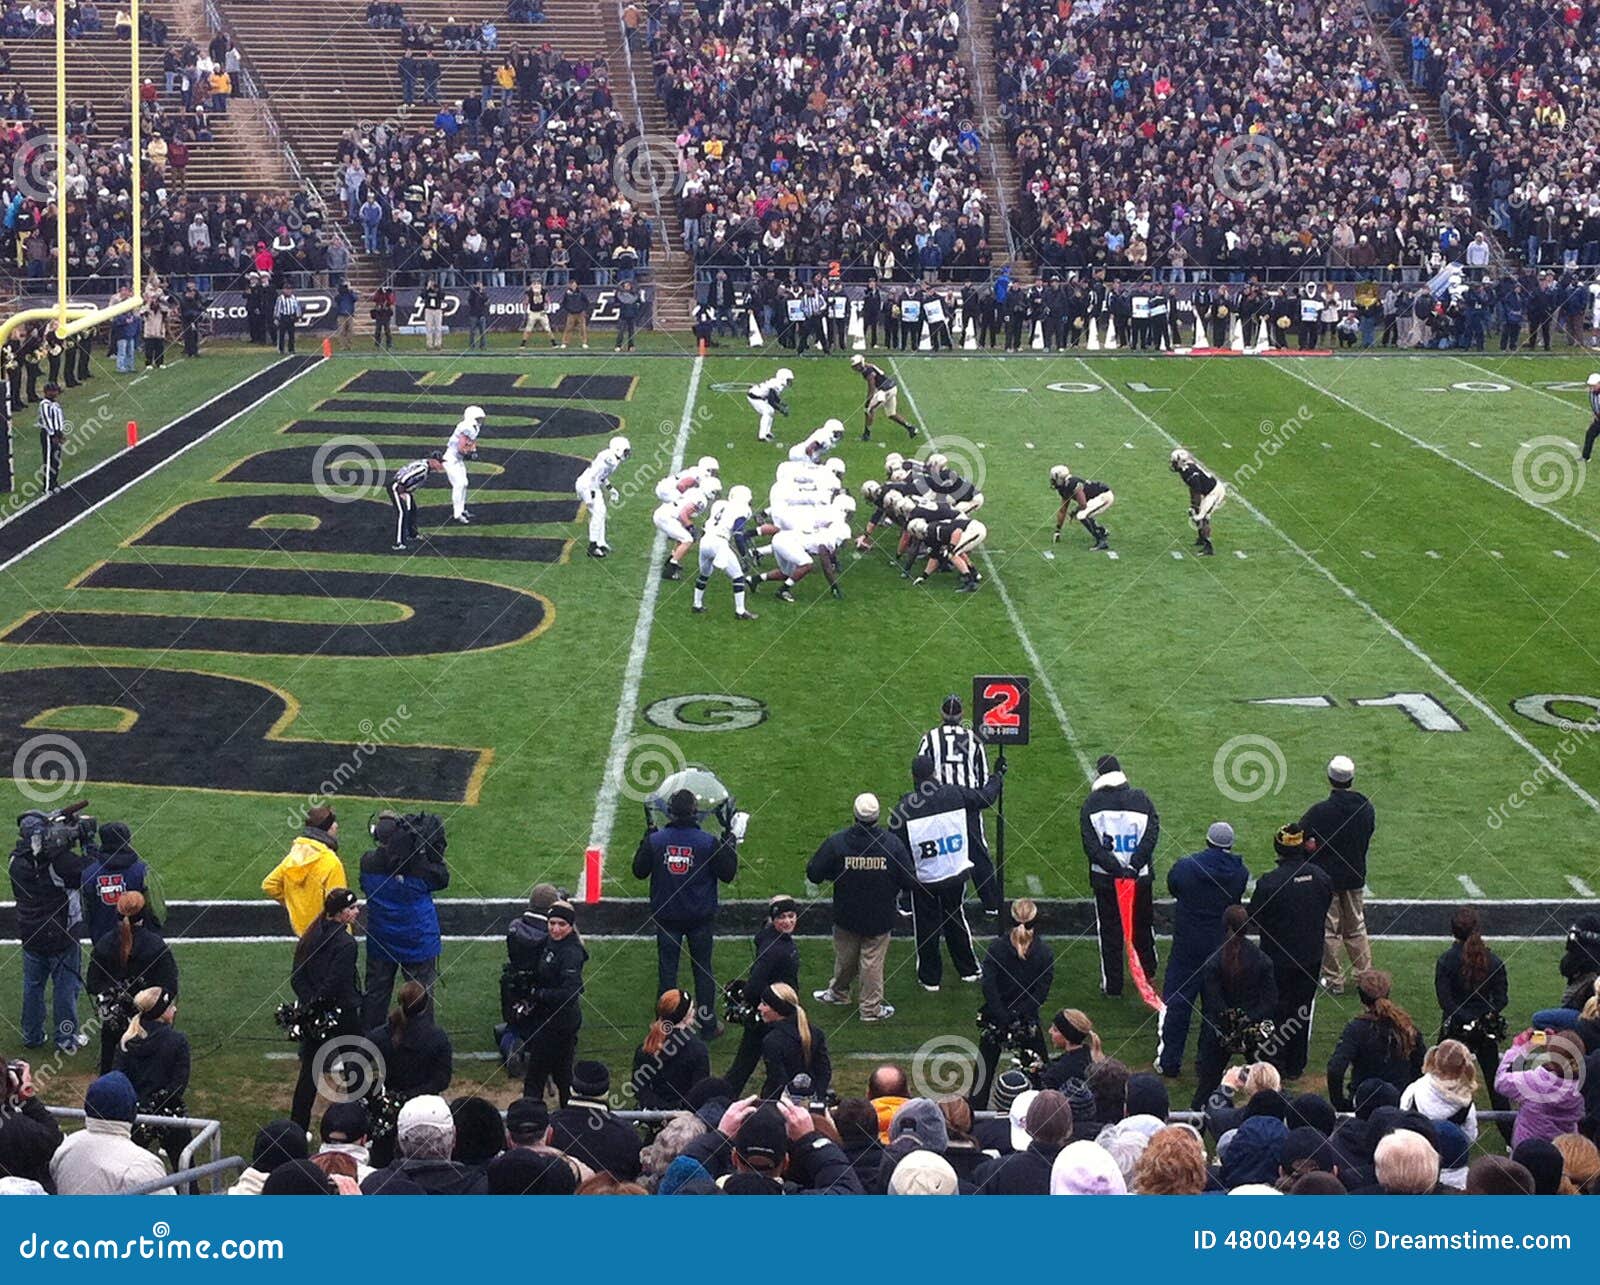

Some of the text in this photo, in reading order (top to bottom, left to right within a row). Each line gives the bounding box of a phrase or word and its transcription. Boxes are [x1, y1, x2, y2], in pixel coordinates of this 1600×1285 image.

[643, 692, 768, 733] G
[983, 683, 1020, 726] 2
[945, 734, 964, 762] L
[844, 856, 888, 871] PURDUE
